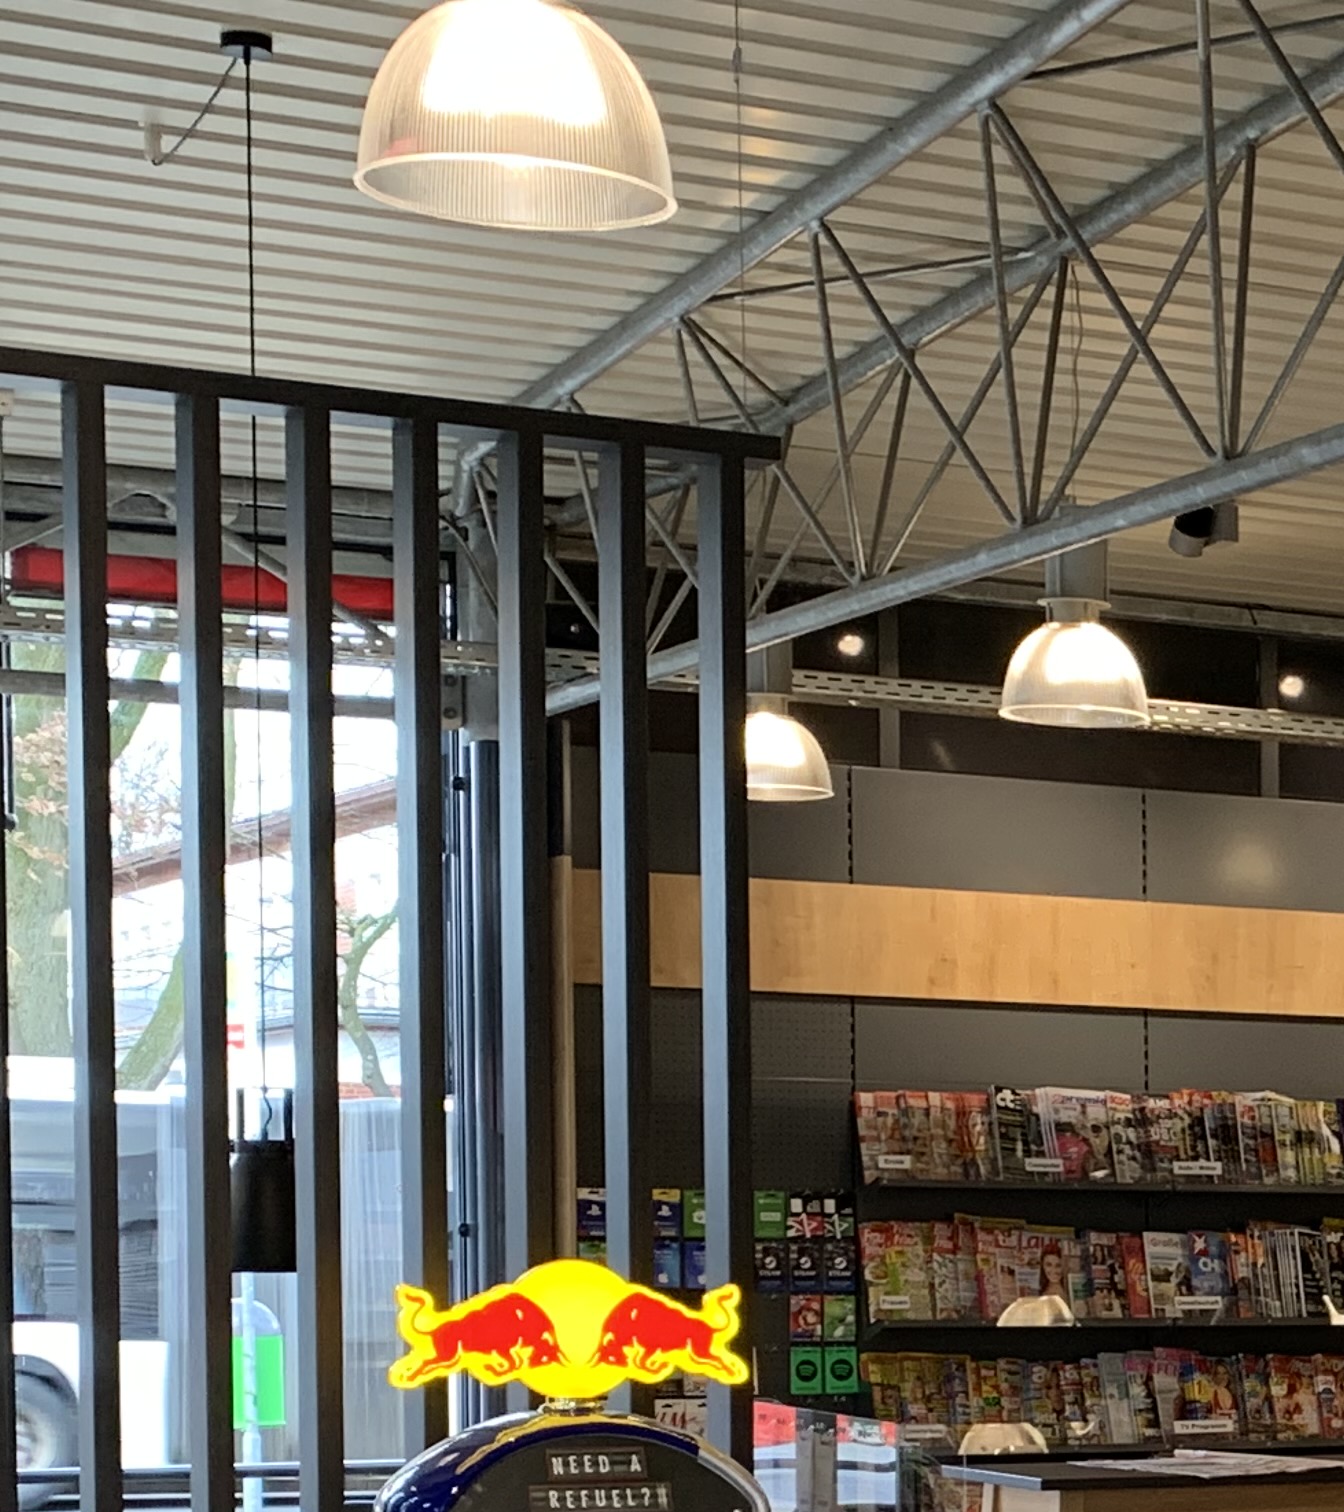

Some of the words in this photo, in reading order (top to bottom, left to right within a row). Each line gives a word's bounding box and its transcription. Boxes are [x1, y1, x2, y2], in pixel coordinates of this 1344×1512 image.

[551, 1455, 611, 1475] NEED
[630, 1454, 641, 1472] A
[548, 1487, 650, 1509] REFUEL?
